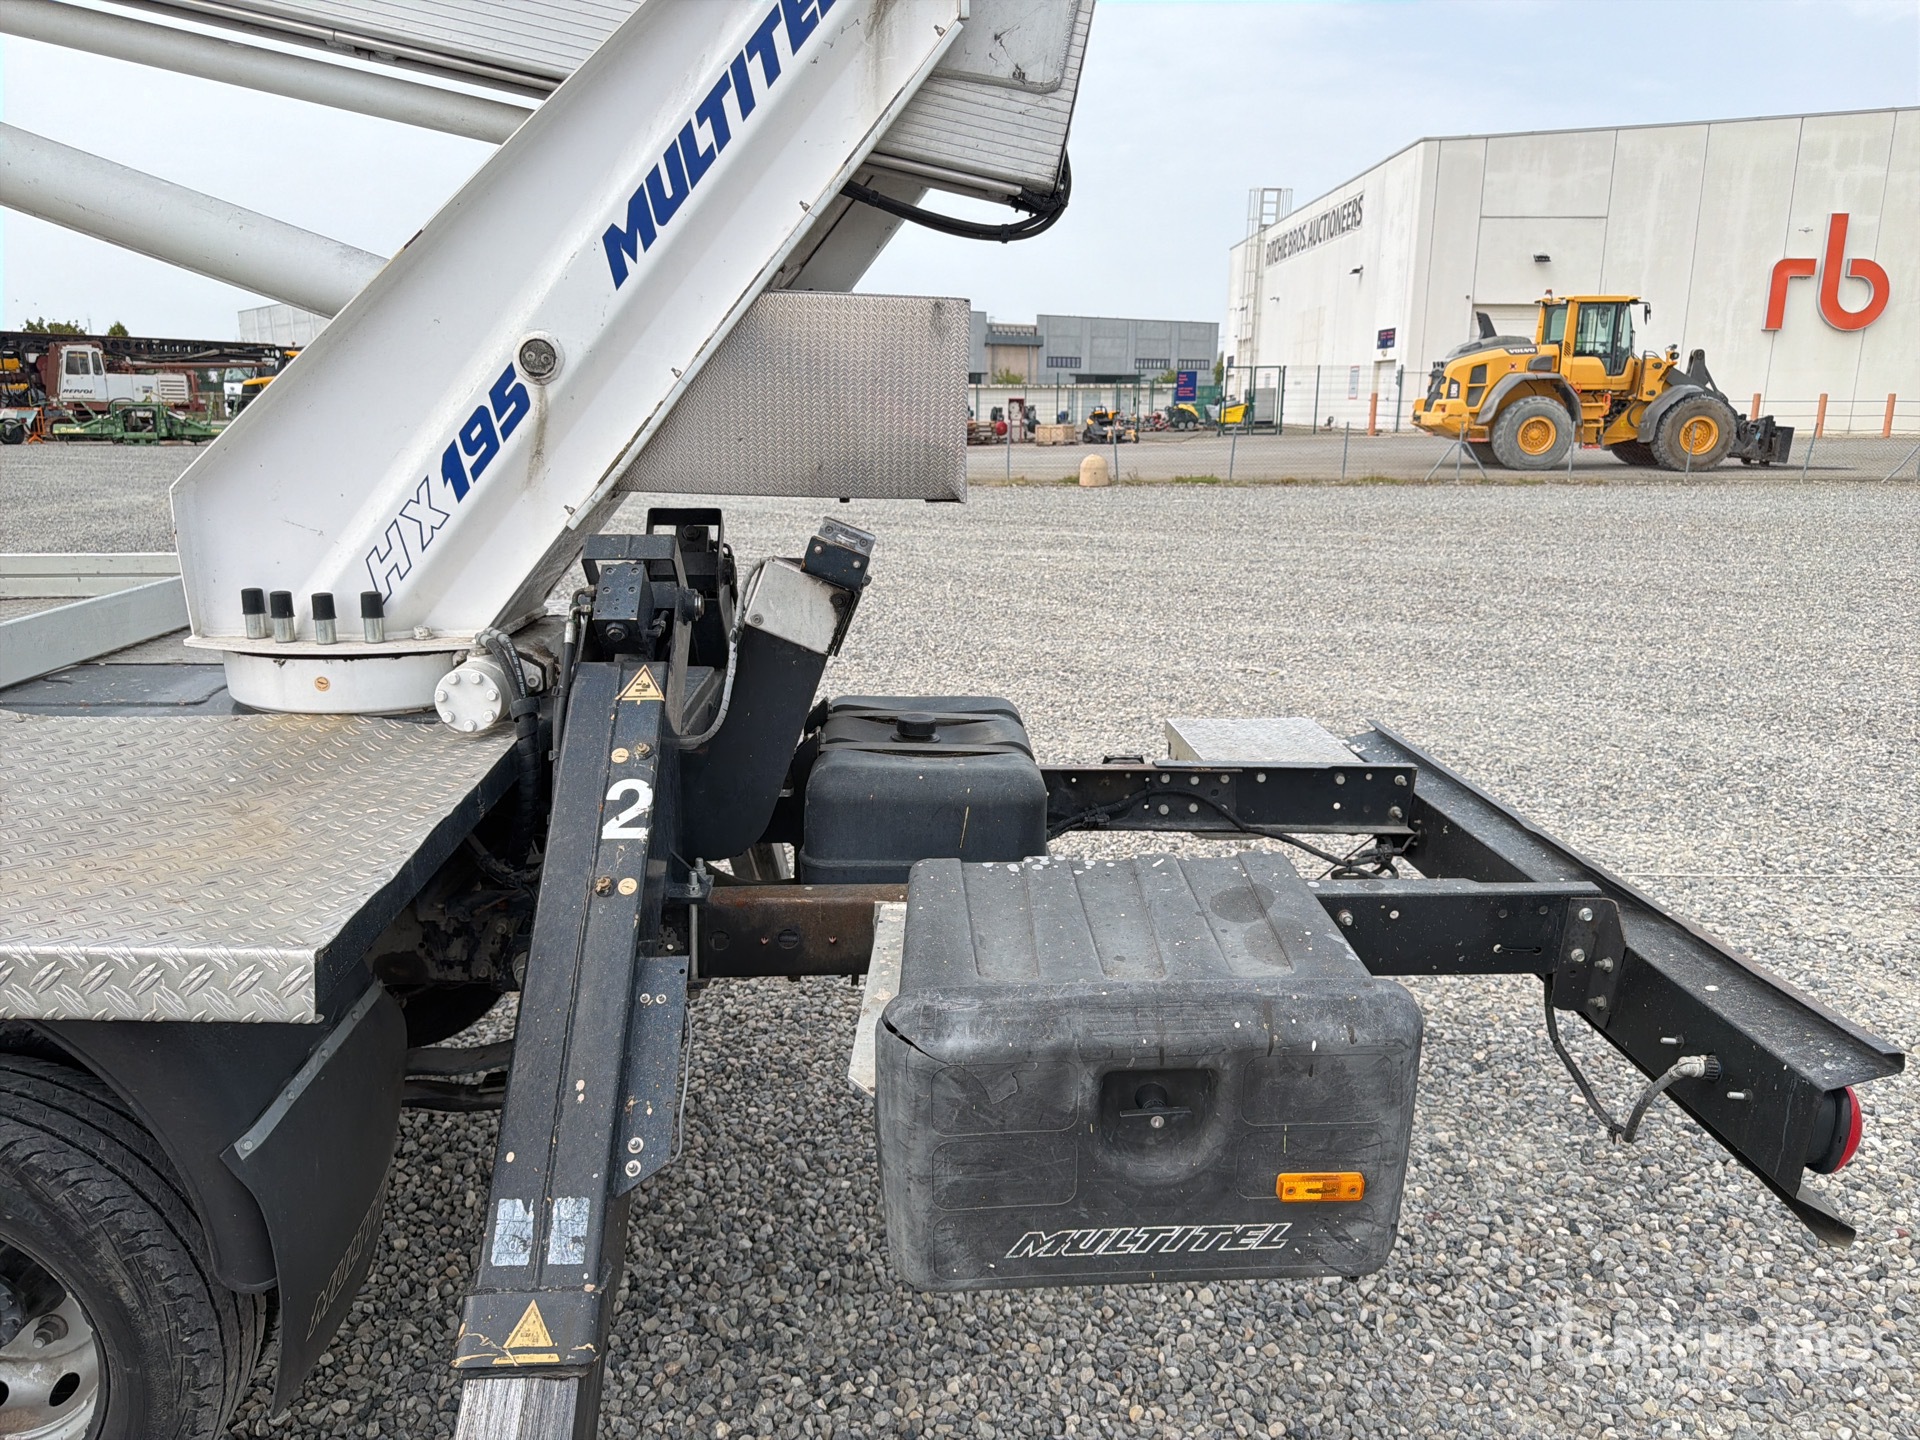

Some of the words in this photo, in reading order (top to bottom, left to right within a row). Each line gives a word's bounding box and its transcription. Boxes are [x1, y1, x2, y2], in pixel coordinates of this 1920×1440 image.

[602, 0, 837, 291] MULTITE
[1265, 232, 1288, 267] RITCHIE
[1307, 194, 1364, 249] AUCTIONEERS
[1761, 212, 1890, 331] rb
[601, 778, 654, 840] 2
[1003, 1222, 1294, 1259] MULTITEL
